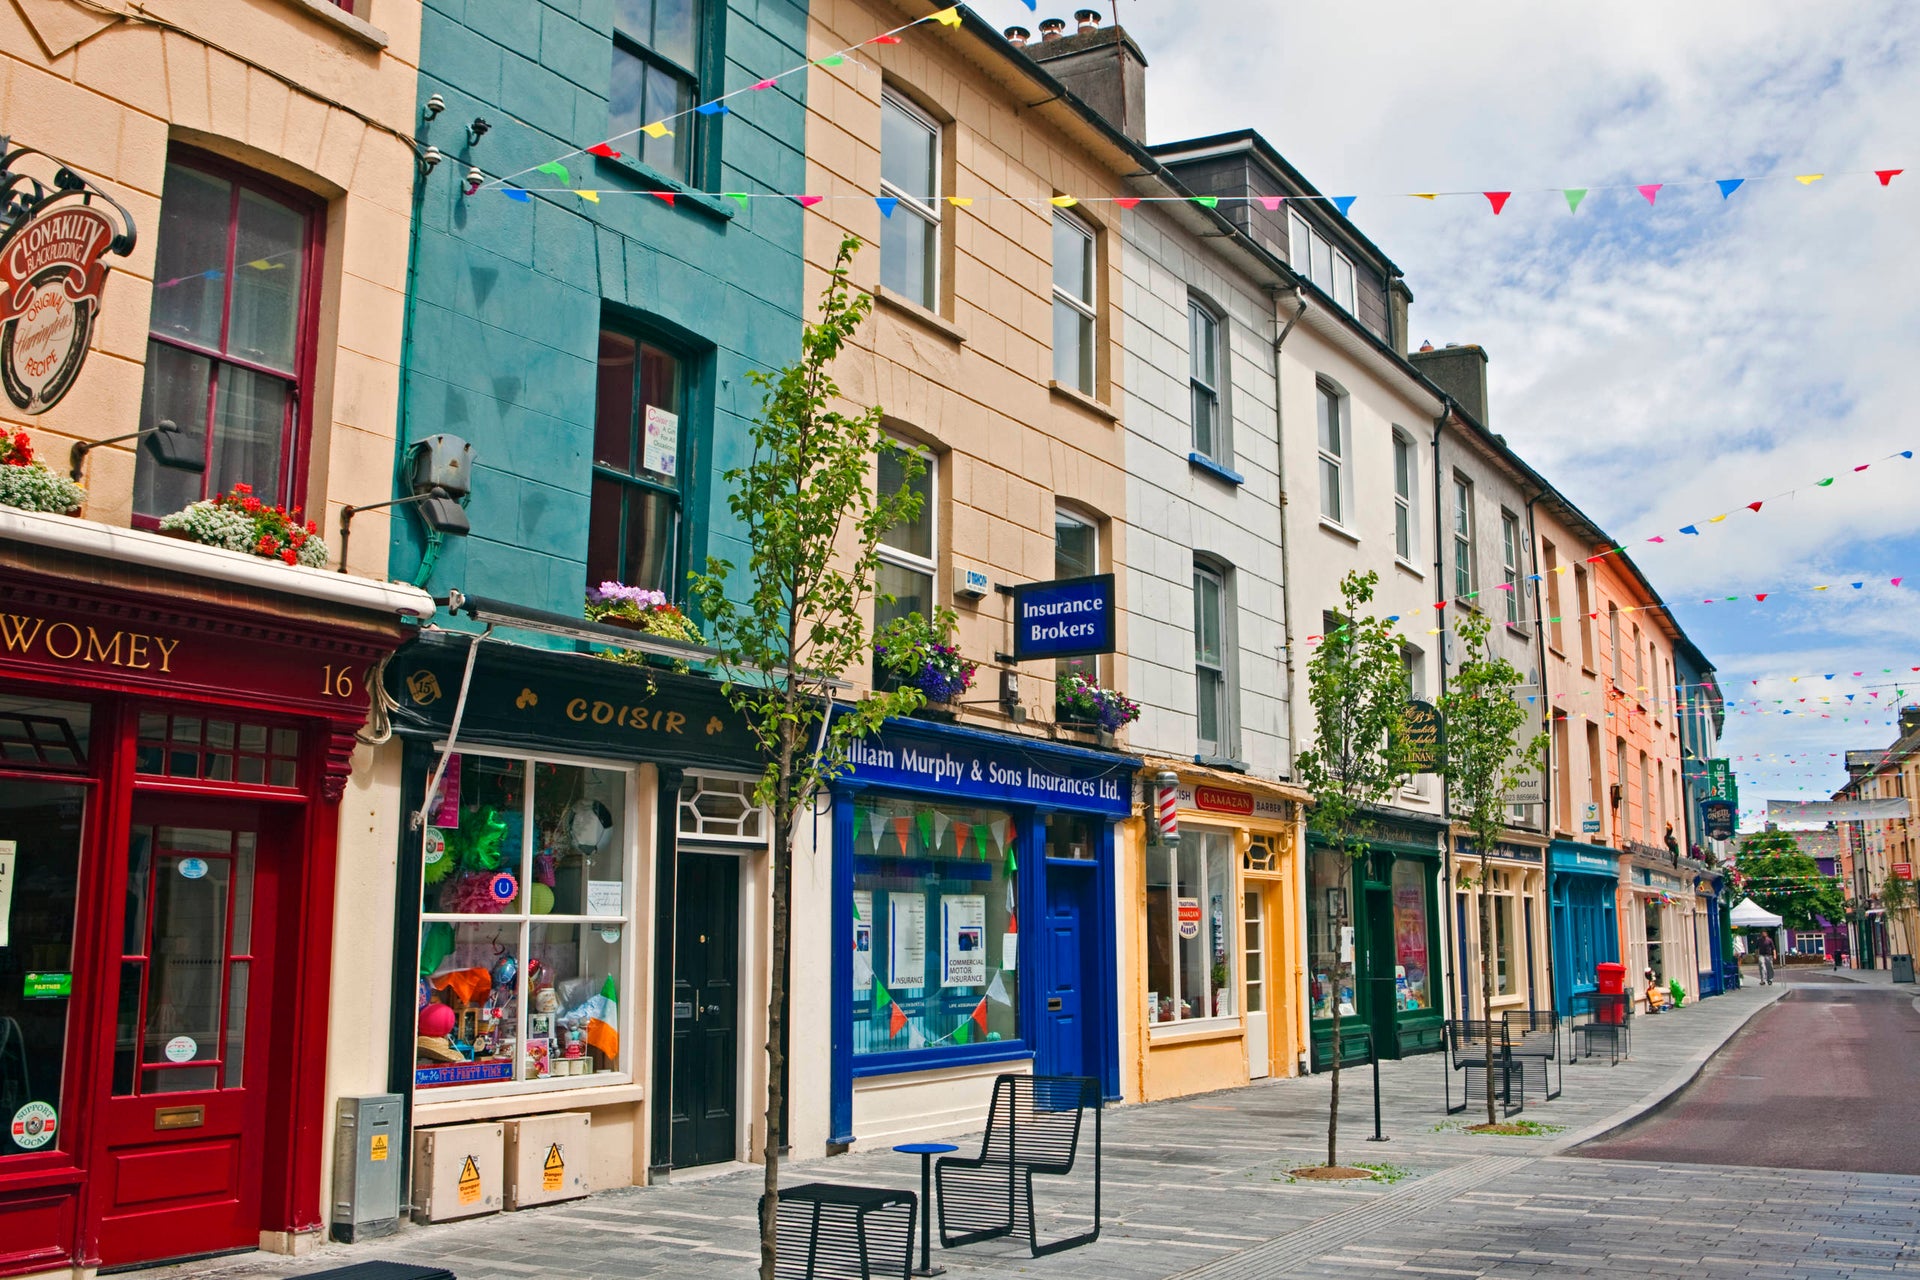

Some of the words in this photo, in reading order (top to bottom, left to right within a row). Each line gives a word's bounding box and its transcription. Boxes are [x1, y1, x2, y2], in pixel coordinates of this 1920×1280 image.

[10, 214, 105, 280] CLONAKILTY
[27, 292, 65, 322] ORIGINAL
[24, 349, 58, 377] RECIPE
[1023, 598, 1103, 618] Insurance
[1031, 621, 1095, 641] Brokers
[0, 613, 180, 672] WOMEY
[321, 664, 353, 698] 16
[566, 697, 687, 735] COISIR
[901, 748, 964, 785] Murphy
[970, 759, 983, 781] &
[989, 761, 1022, 787] Sons
[1027, 767, 1095, 797] Insurances
[1099, 778, 1121, 801] Ltd.
[1202, 792, 1250, 809] RAMAZAN
[1256, 801, 1282, 813] BARBER
[949, 966, 972, 974] MOTOR
[949, 974, 983, 983] INSURANCE
[896, 976, 923, 985] INSURANCE
[456, 1065, 481, 1080] PARTY
[482, 1065, 502, 1078] TIME
[17, 1104, 53, 1120] SUPPORT
[18, 1136, 48, 1146] LOCAL
